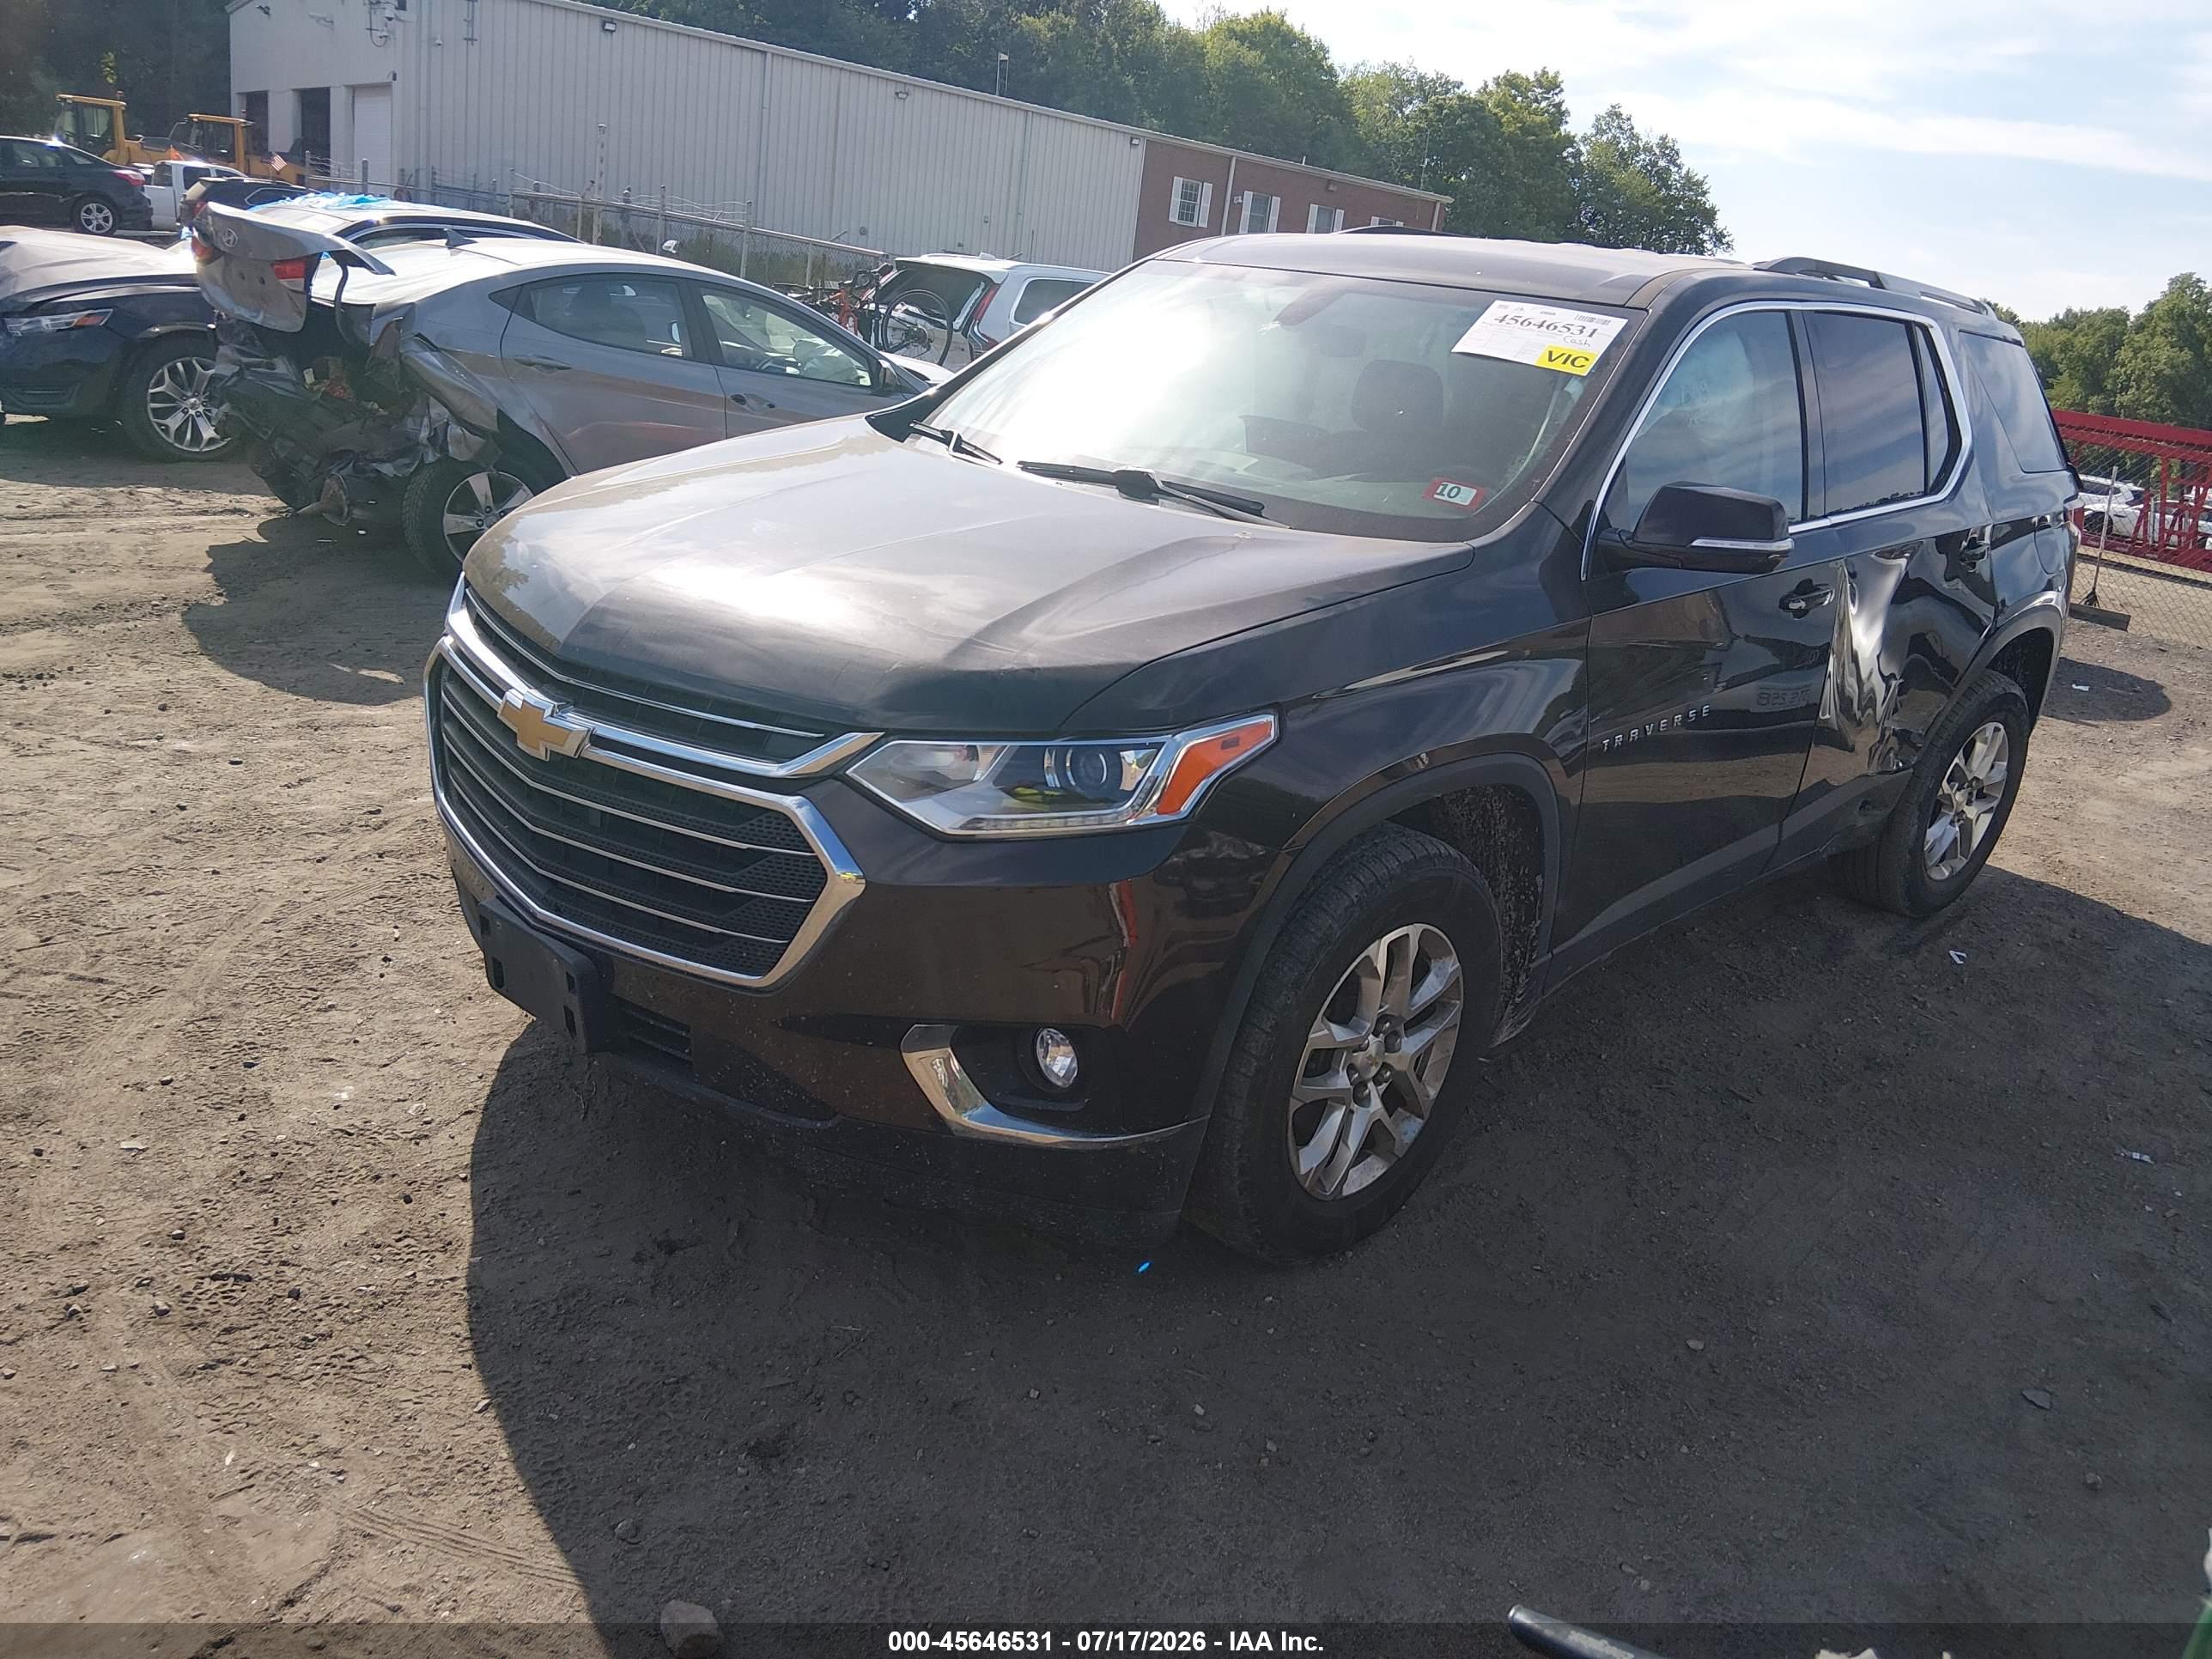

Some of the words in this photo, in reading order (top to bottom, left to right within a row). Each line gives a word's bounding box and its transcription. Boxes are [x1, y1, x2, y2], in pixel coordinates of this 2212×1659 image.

[1493, 313, 1599, 338] 45646531
[1562, 335, 1591, 347] Cash
[1547, 350, 1590, 368] VIC
[1435, 483, 1462, 499] 10
[1601, 704, 1711, 752] TRAVERSE
